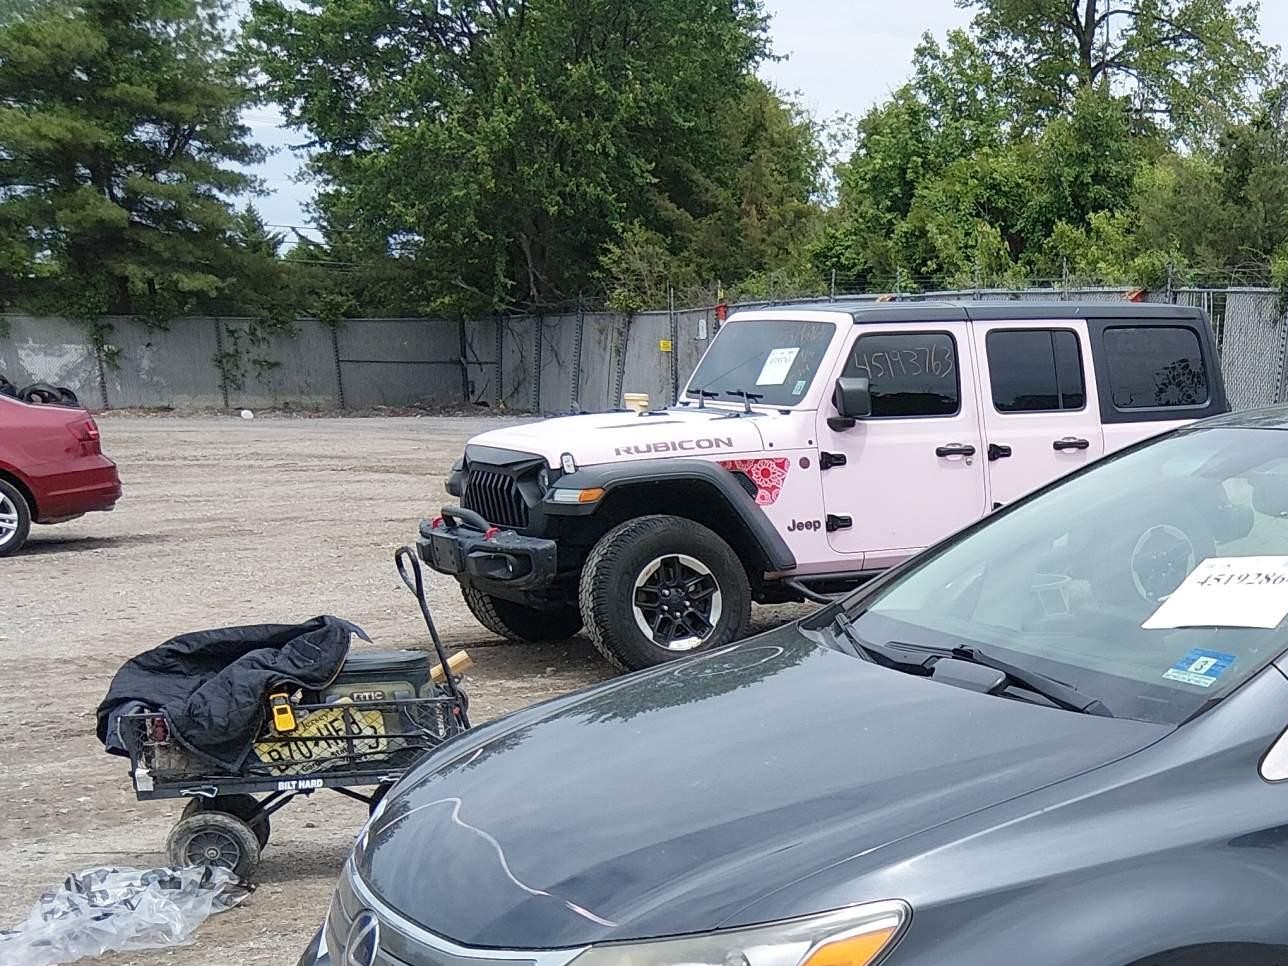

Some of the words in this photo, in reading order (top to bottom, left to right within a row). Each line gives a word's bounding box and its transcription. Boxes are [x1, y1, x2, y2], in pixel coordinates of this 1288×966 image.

[854, 343, 954, 379] 45193763
[614, 437, 734, 456] RUBICON
[787, 519, 822, 532] Jeep
[278, 780, 297, 791] BILT
[298, 778, 324, 790] HARD
